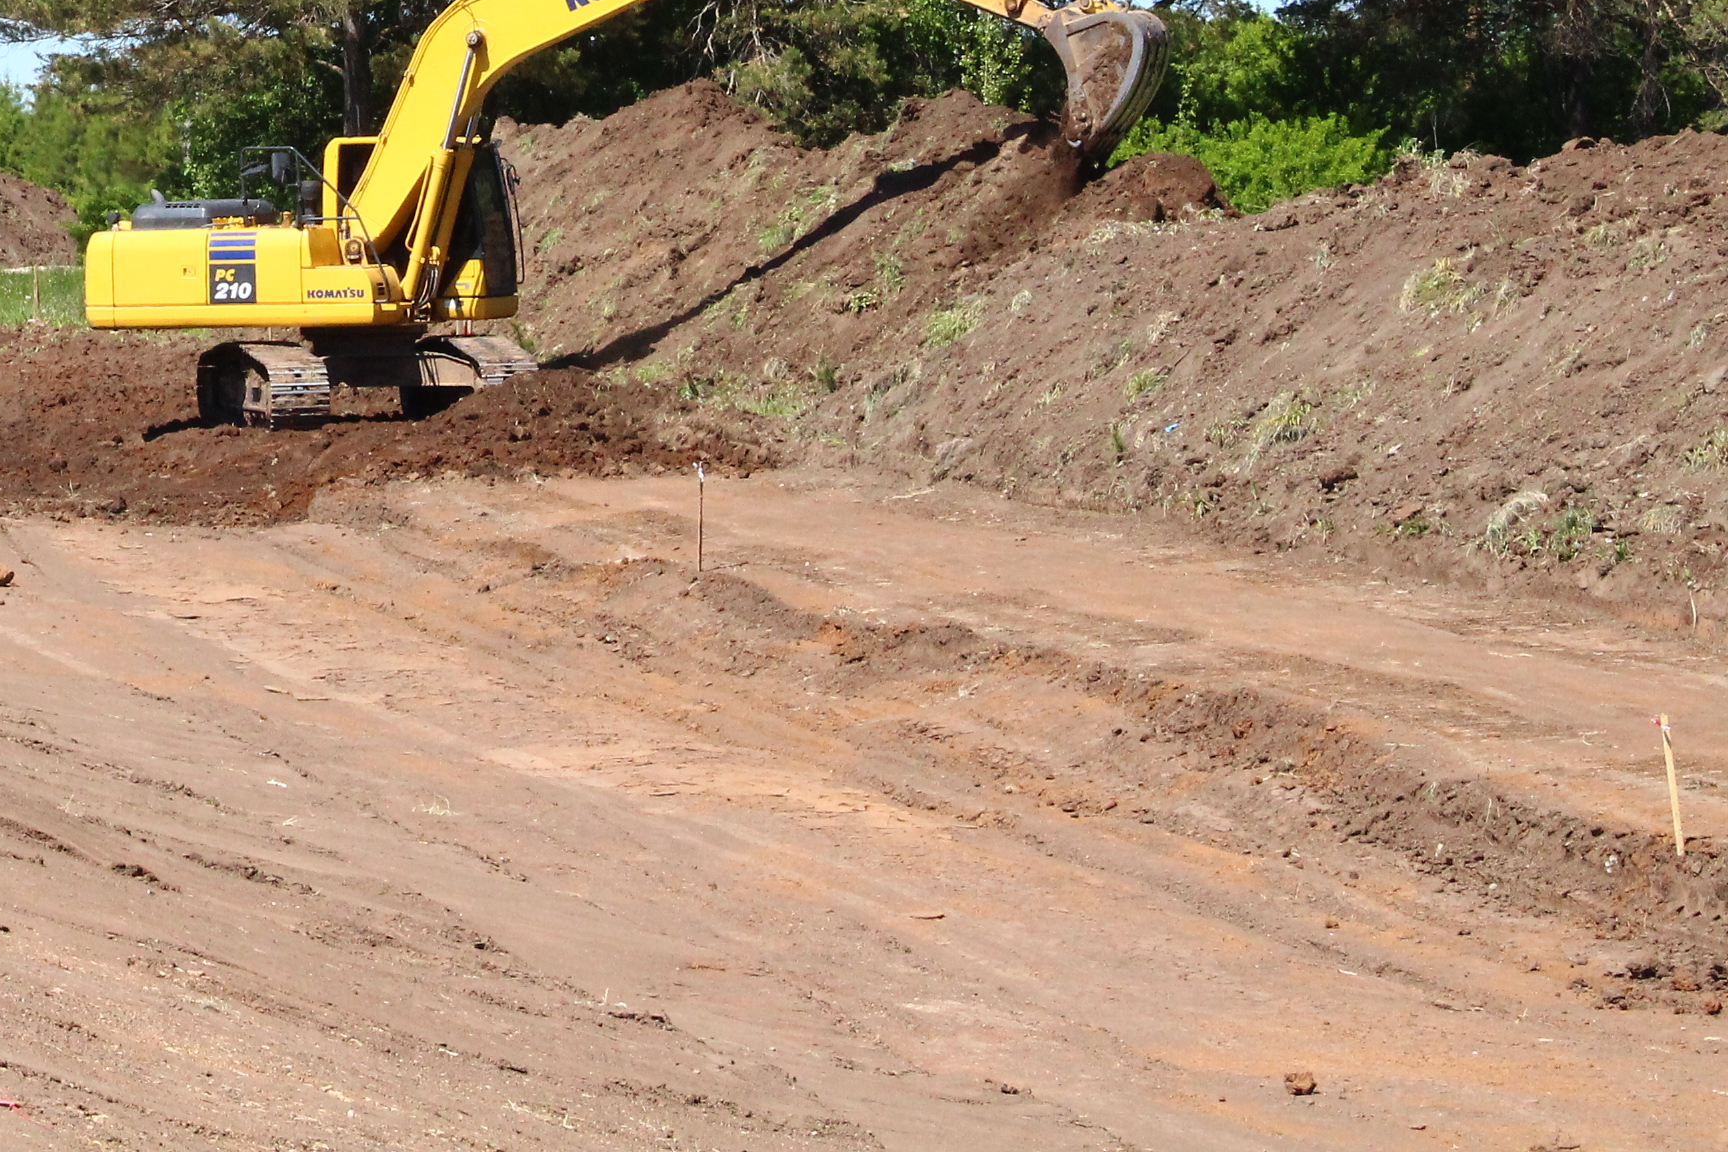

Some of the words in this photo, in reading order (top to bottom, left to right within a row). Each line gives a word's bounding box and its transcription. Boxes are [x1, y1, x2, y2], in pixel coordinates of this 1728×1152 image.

[214, 269, 235, 282] PC
[214, 282, 252, 300] 210
[307, 287, 365, 299] KOMATSU
